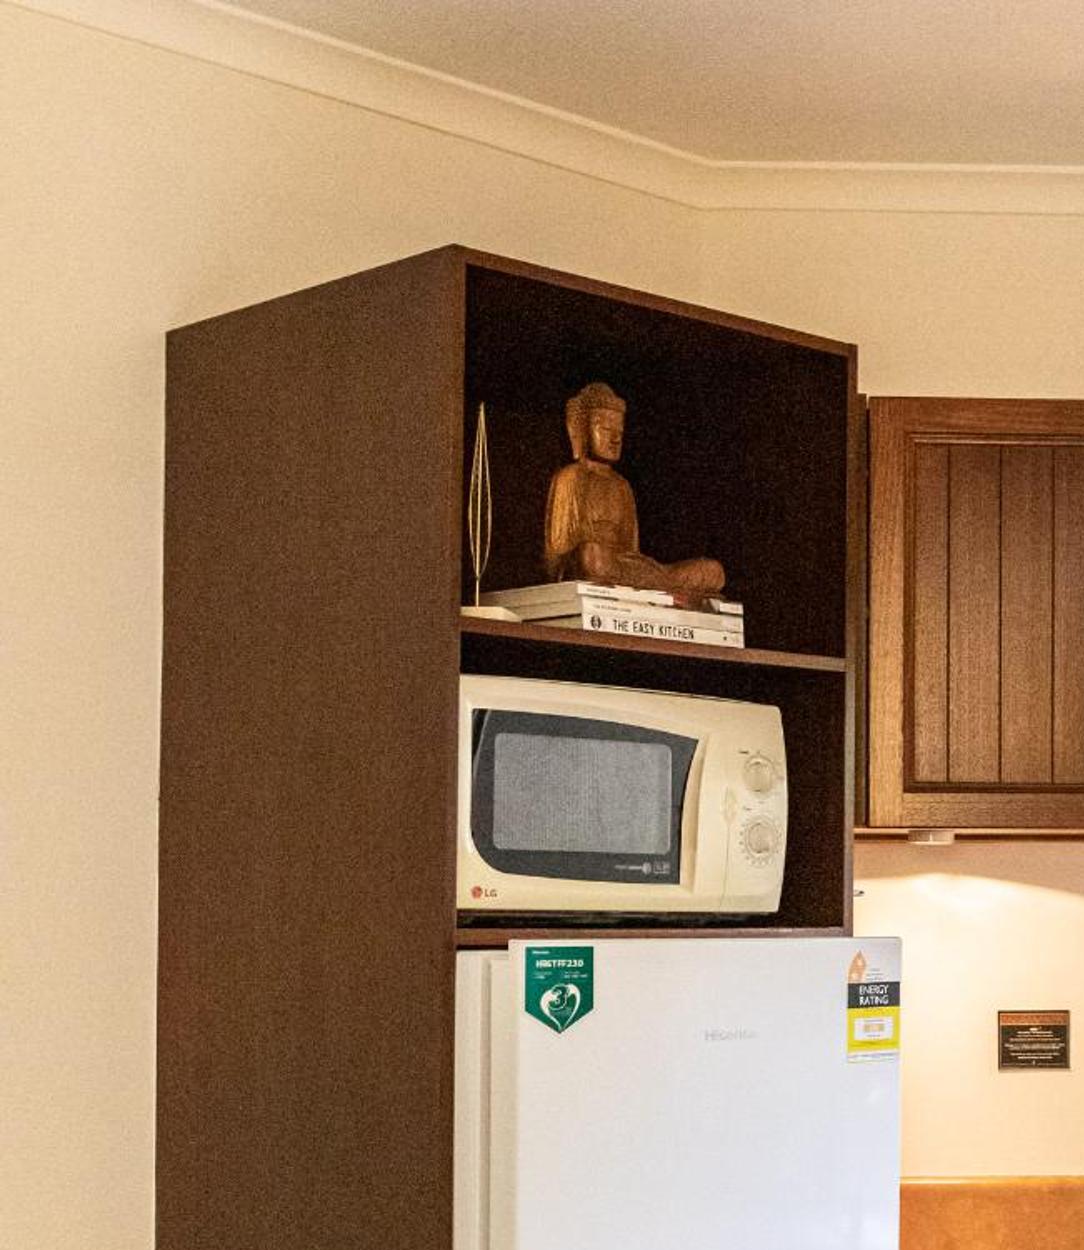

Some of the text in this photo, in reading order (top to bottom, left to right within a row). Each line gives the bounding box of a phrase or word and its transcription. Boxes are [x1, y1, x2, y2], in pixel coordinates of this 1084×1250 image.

[612, 619, 695, 640] THE EASY KITCHEN
[858, 984, 888, 995] ENERGY
[858, 995, 889, 1006] RATING
